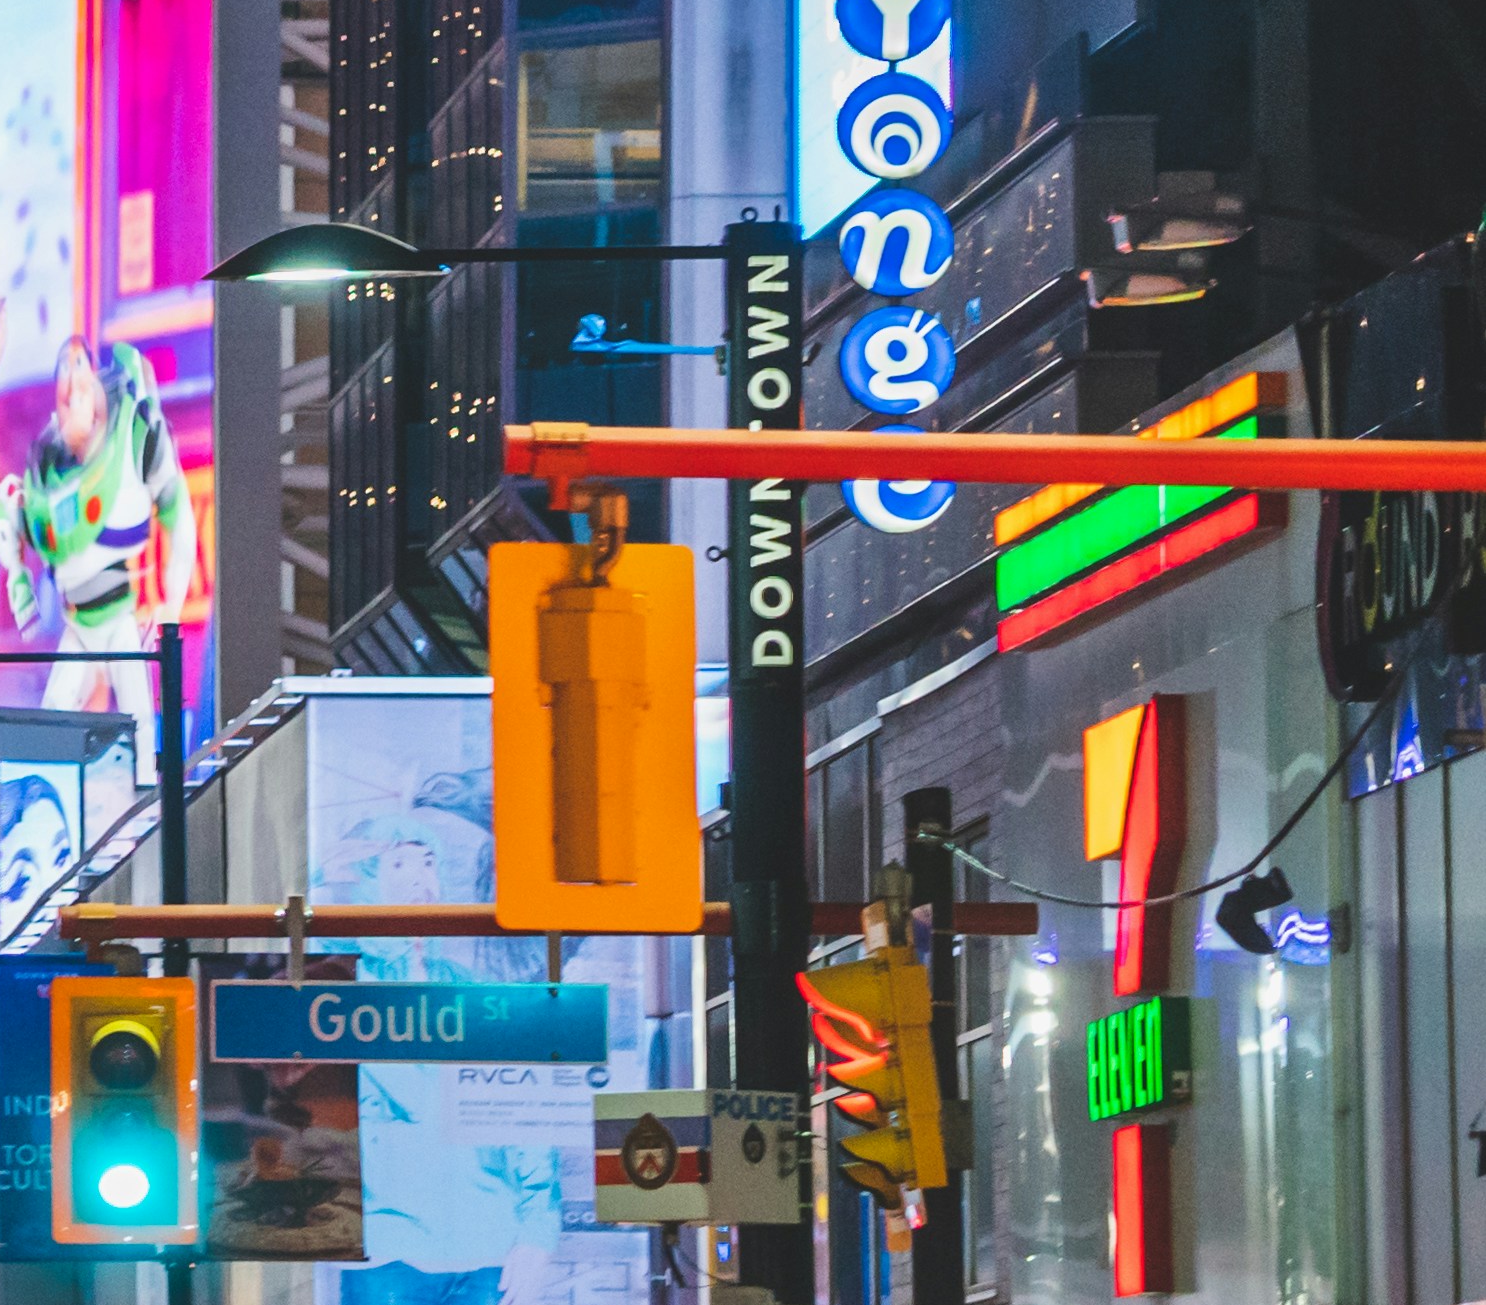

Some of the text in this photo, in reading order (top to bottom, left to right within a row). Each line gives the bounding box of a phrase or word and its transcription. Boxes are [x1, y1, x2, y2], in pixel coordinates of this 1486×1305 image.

[748, 255, 793, 667] DOWNOWN
[307, 993, 512, 1045] Gould St
[458, 1067, 539, 1086] RVCA
[713, 1092, 795, 1122] POLICE
